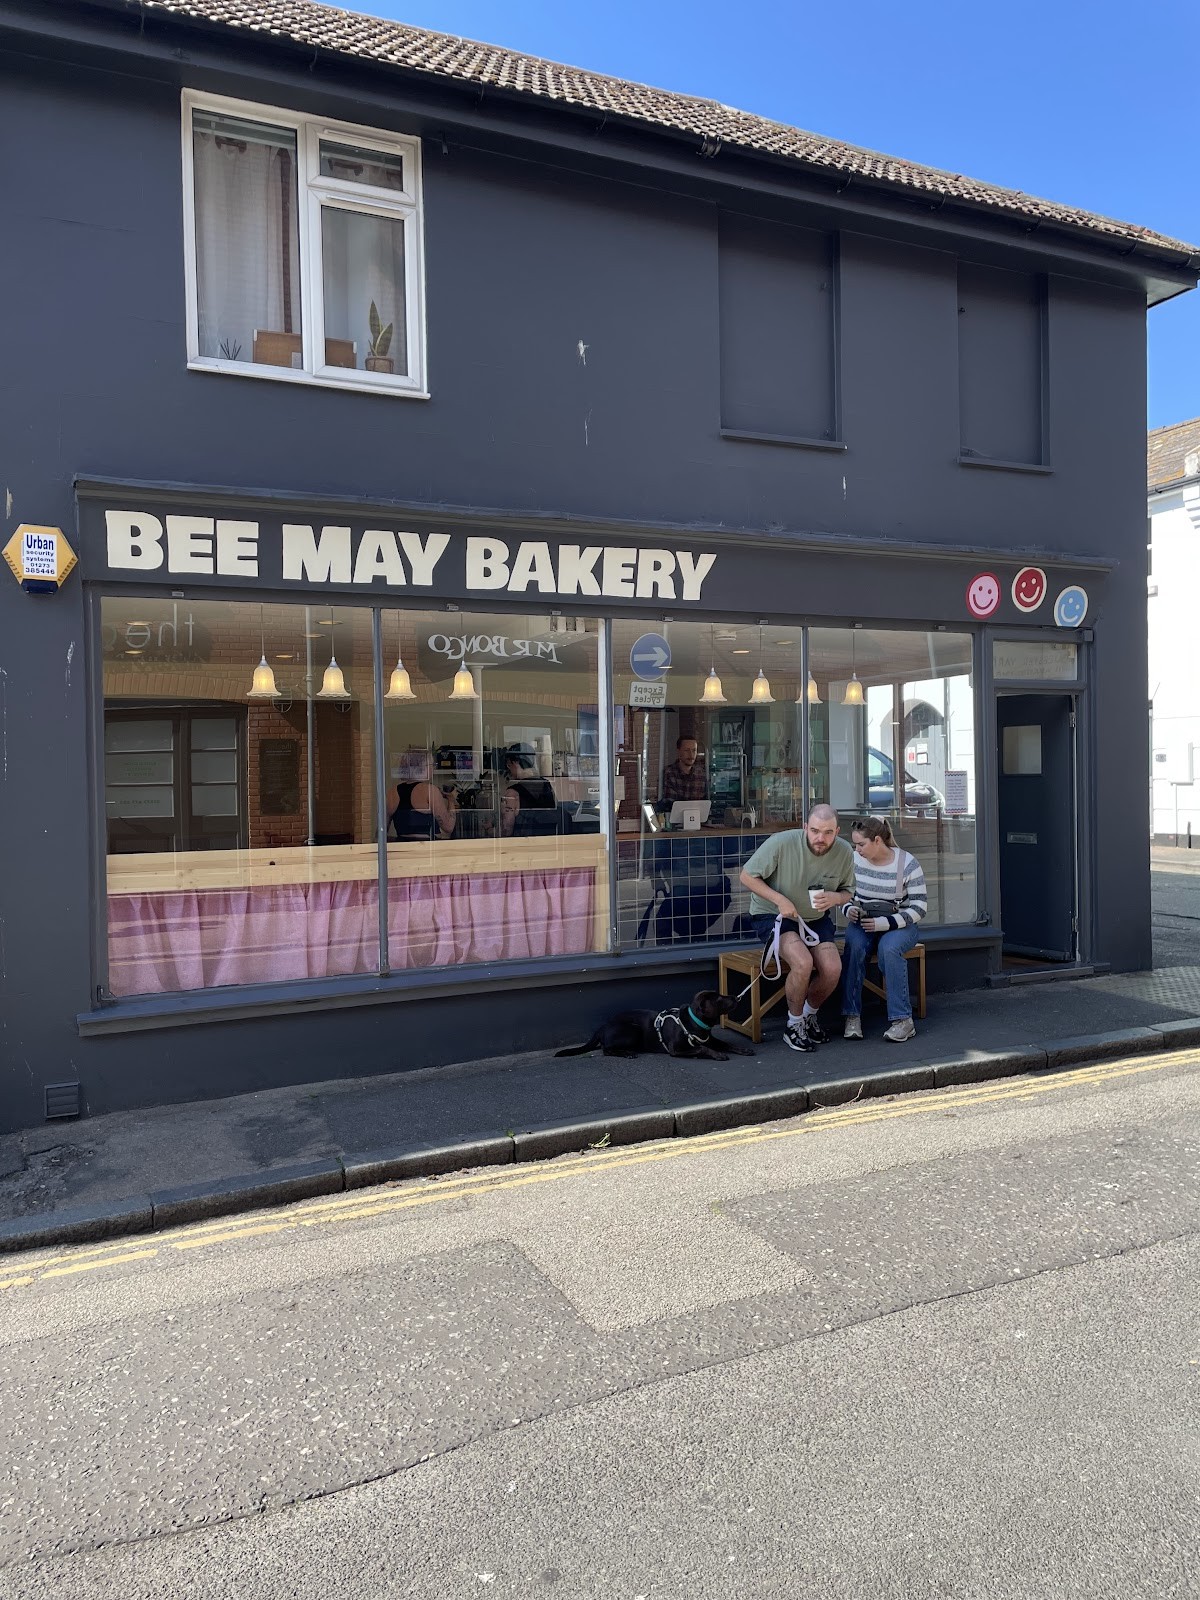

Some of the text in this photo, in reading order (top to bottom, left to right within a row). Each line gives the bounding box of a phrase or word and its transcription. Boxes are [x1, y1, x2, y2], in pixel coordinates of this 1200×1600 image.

[26, 534, 54, 550] Urban
[104, 510, 717, 601] BEE MAY BAKERY
